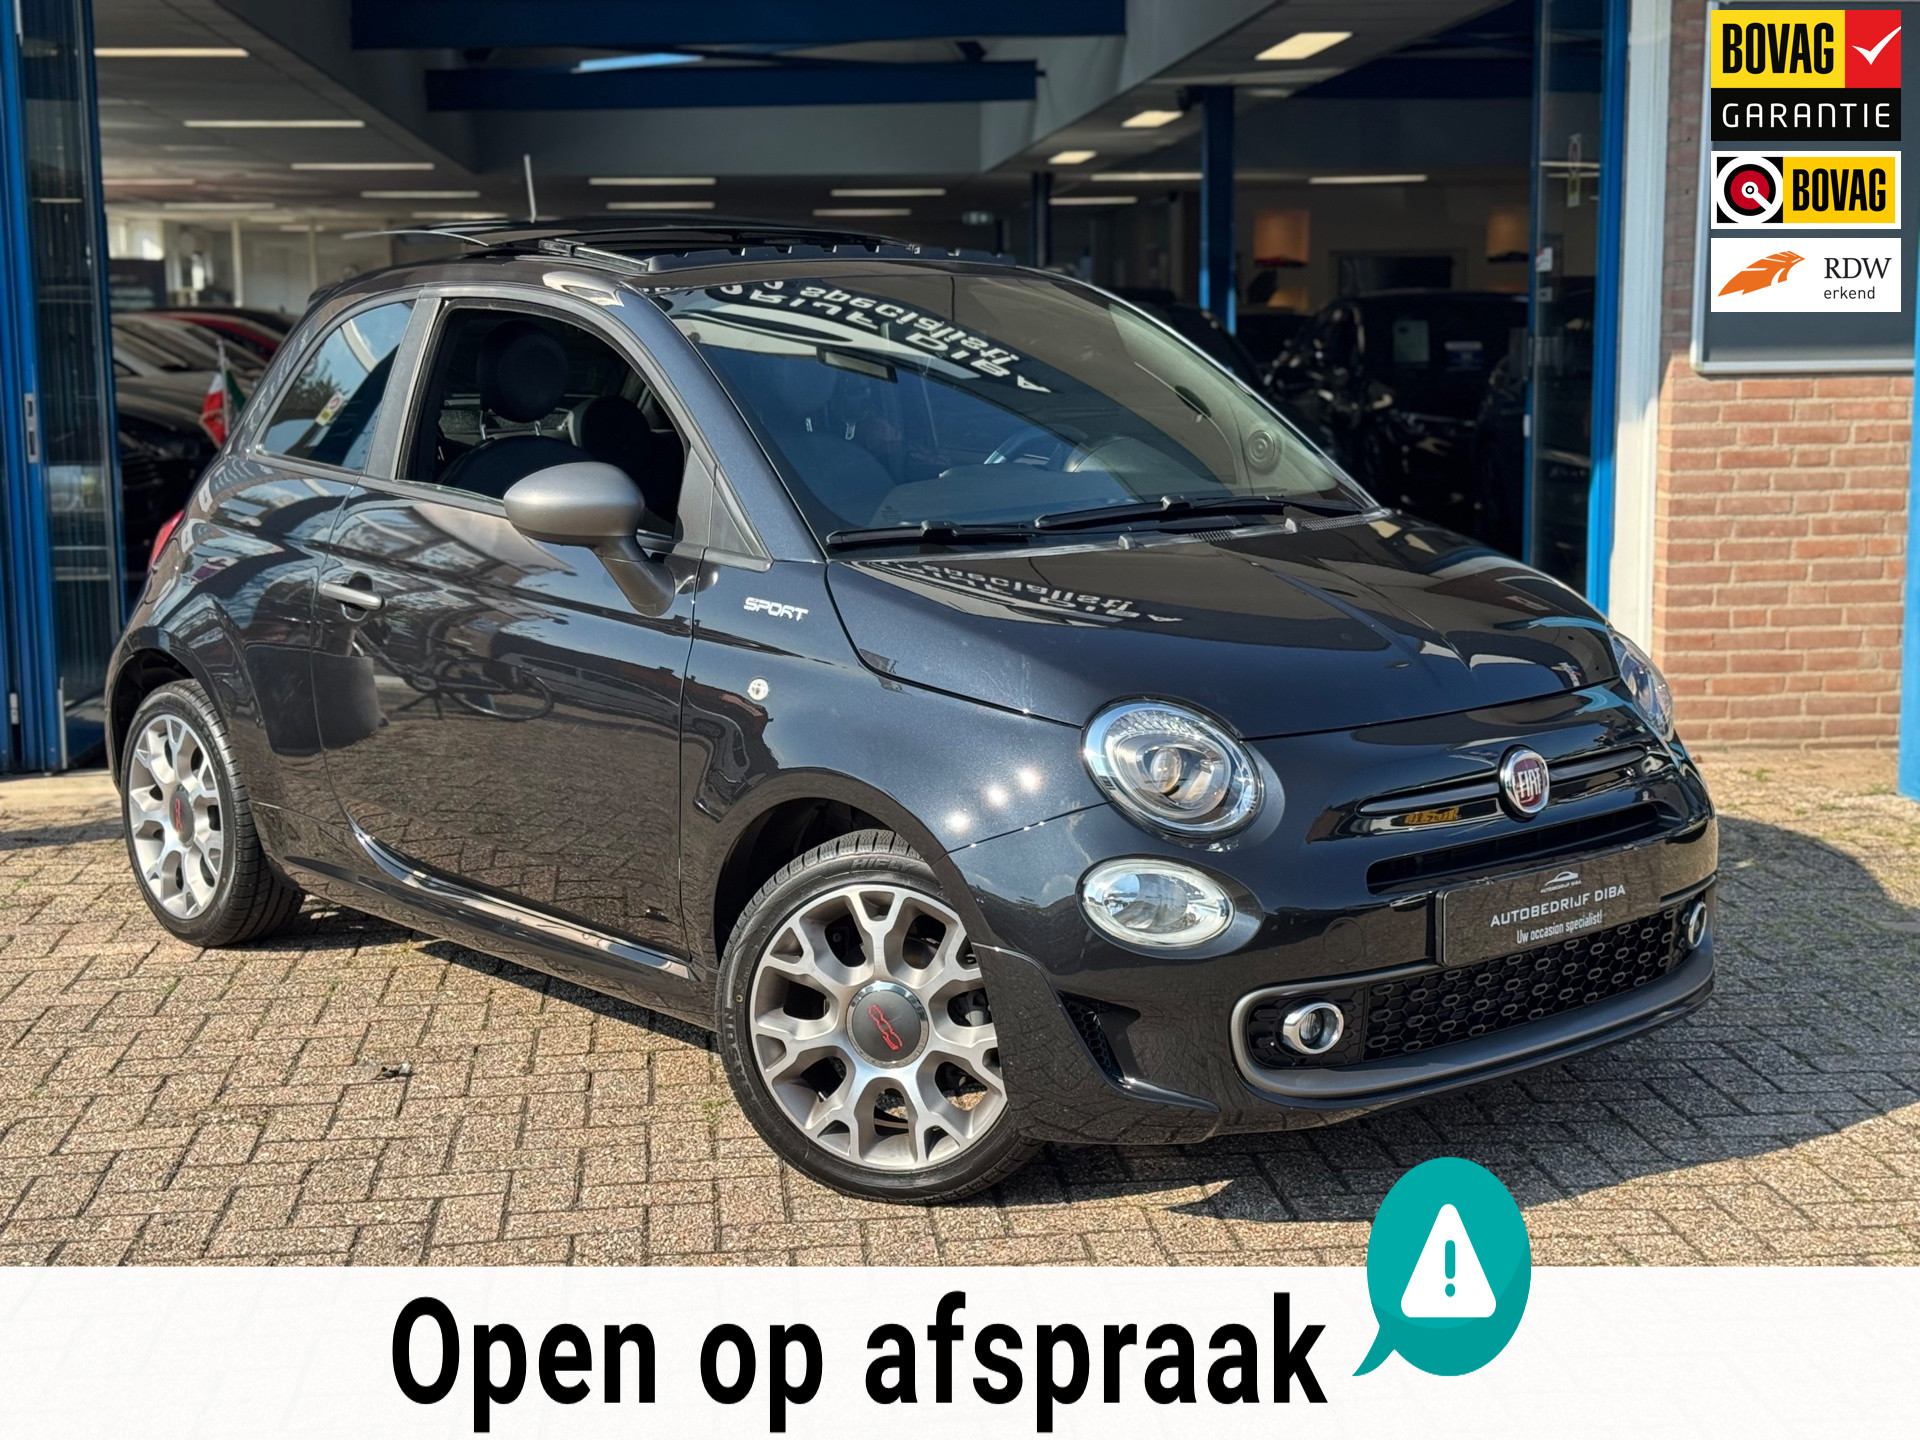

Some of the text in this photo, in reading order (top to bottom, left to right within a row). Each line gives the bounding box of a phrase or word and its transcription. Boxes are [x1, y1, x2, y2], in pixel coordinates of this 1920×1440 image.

[743, 597, 809, 621] SPORT
[1517, 767, 1542, 799] FIAT
[1490, 884, 1626, 928] AUTOBEDRIJF DIBA
[1516, 909, 1603, 944] Uw occasion specialist!
